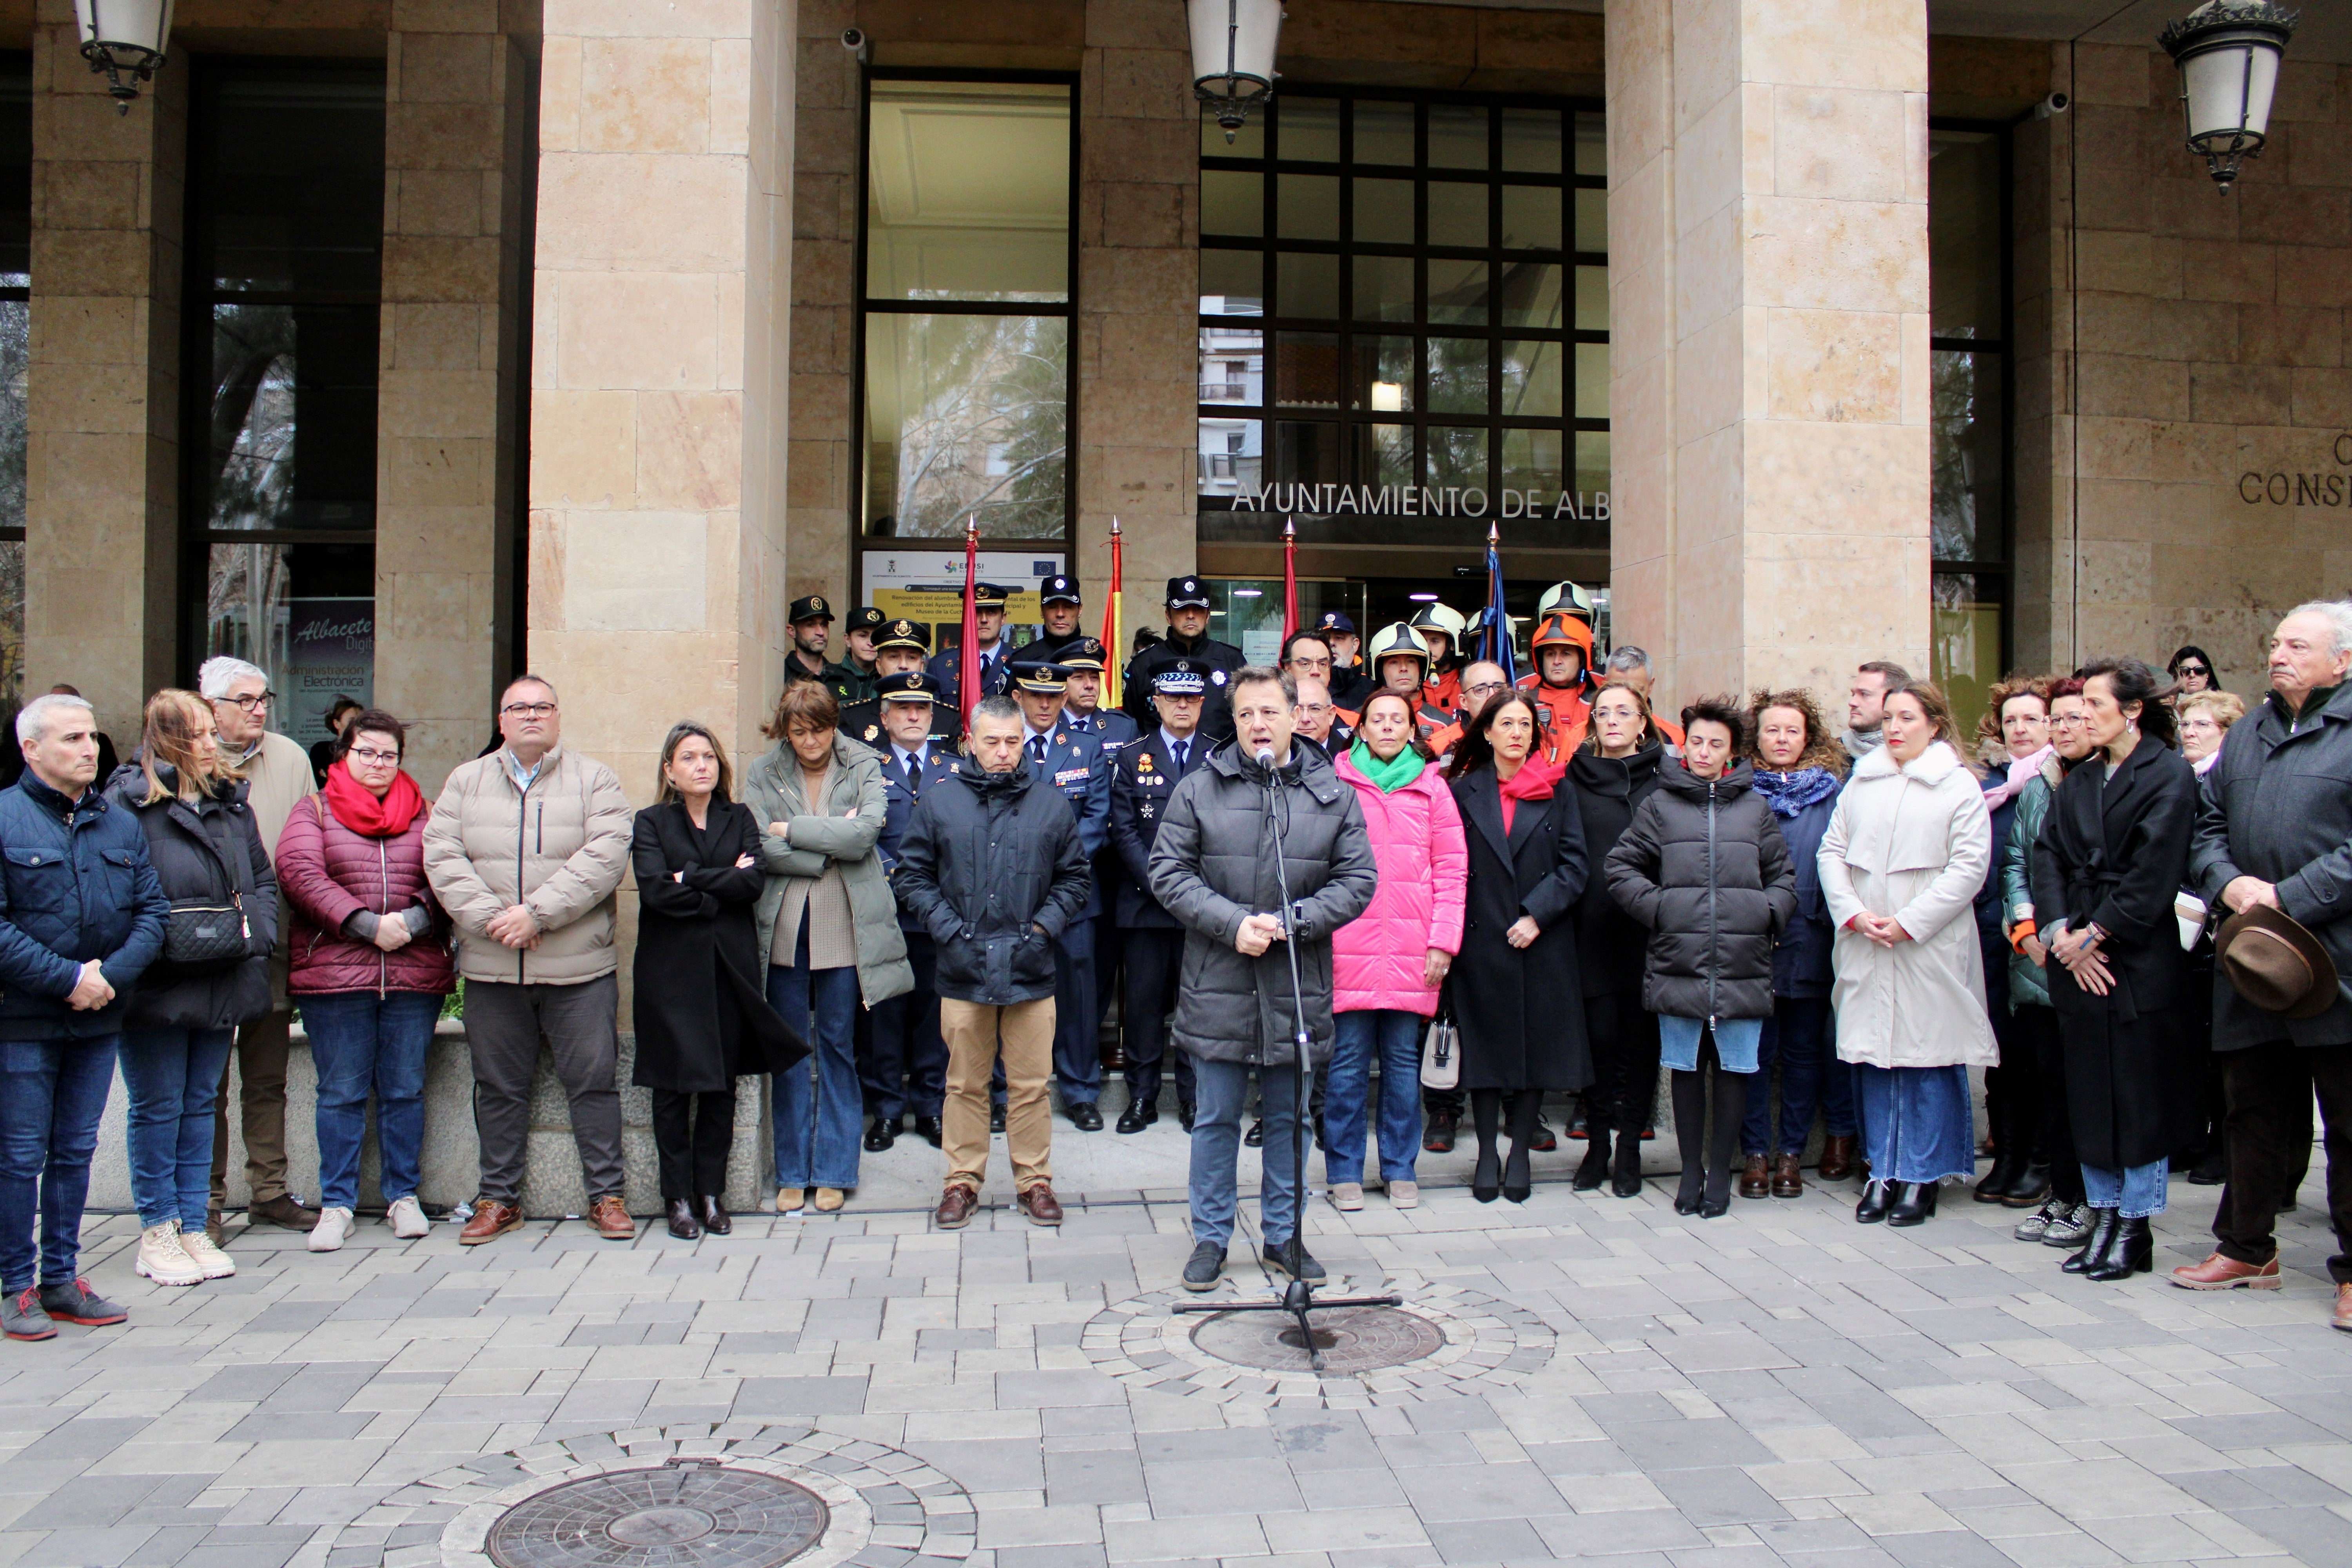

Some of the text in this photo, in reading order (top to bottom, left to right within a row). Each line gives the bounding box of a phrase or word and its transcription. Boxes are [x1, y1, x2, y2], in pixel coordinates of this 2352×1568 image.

[1231, 482, 1610, 521] AYUNTAMIENTO DE ALB
[294, 617, 372, 643] Albacete
[304, 675, 364, 687] Electrónica
